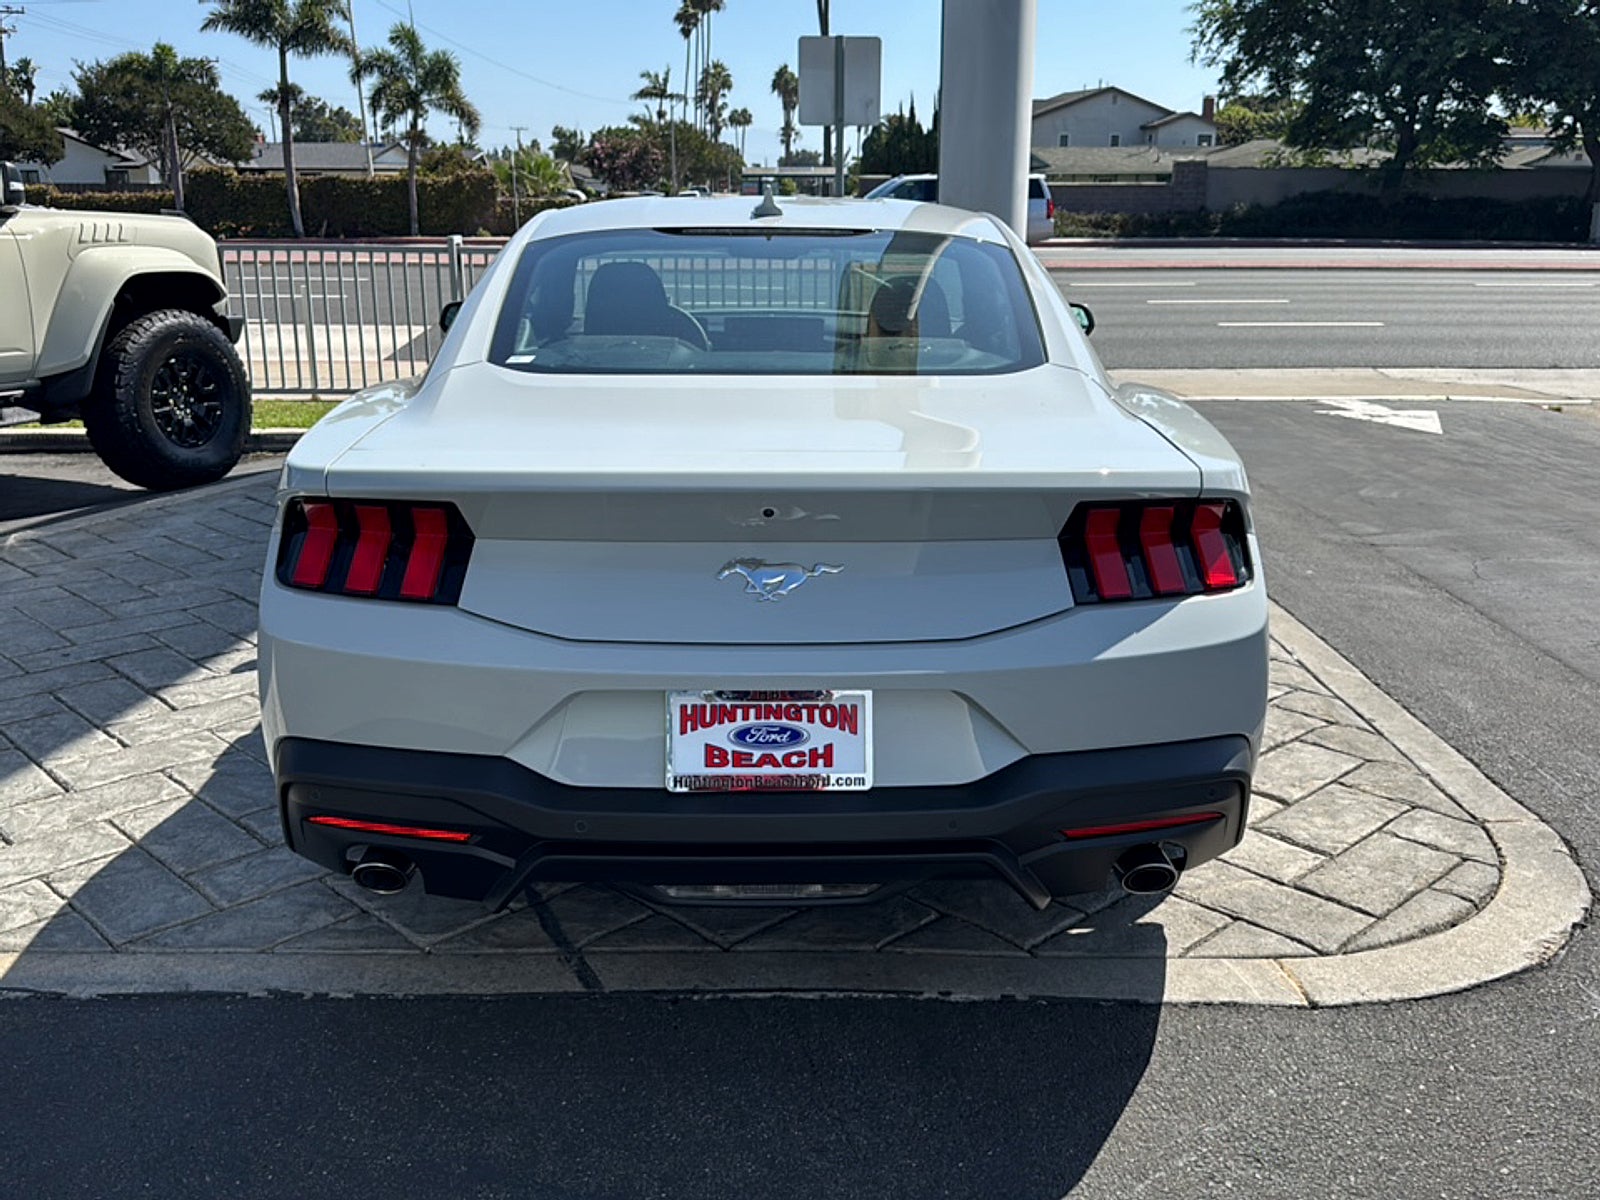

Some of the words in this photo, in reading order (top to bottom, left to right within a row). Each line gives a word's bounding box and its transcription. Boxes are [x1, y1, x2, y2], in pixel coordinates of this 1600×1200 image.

[680, 703, 858, 736] HUNTINGTON
[745, 725, 792, 743] Ford
[704, 742, 833, 768] BEACH
